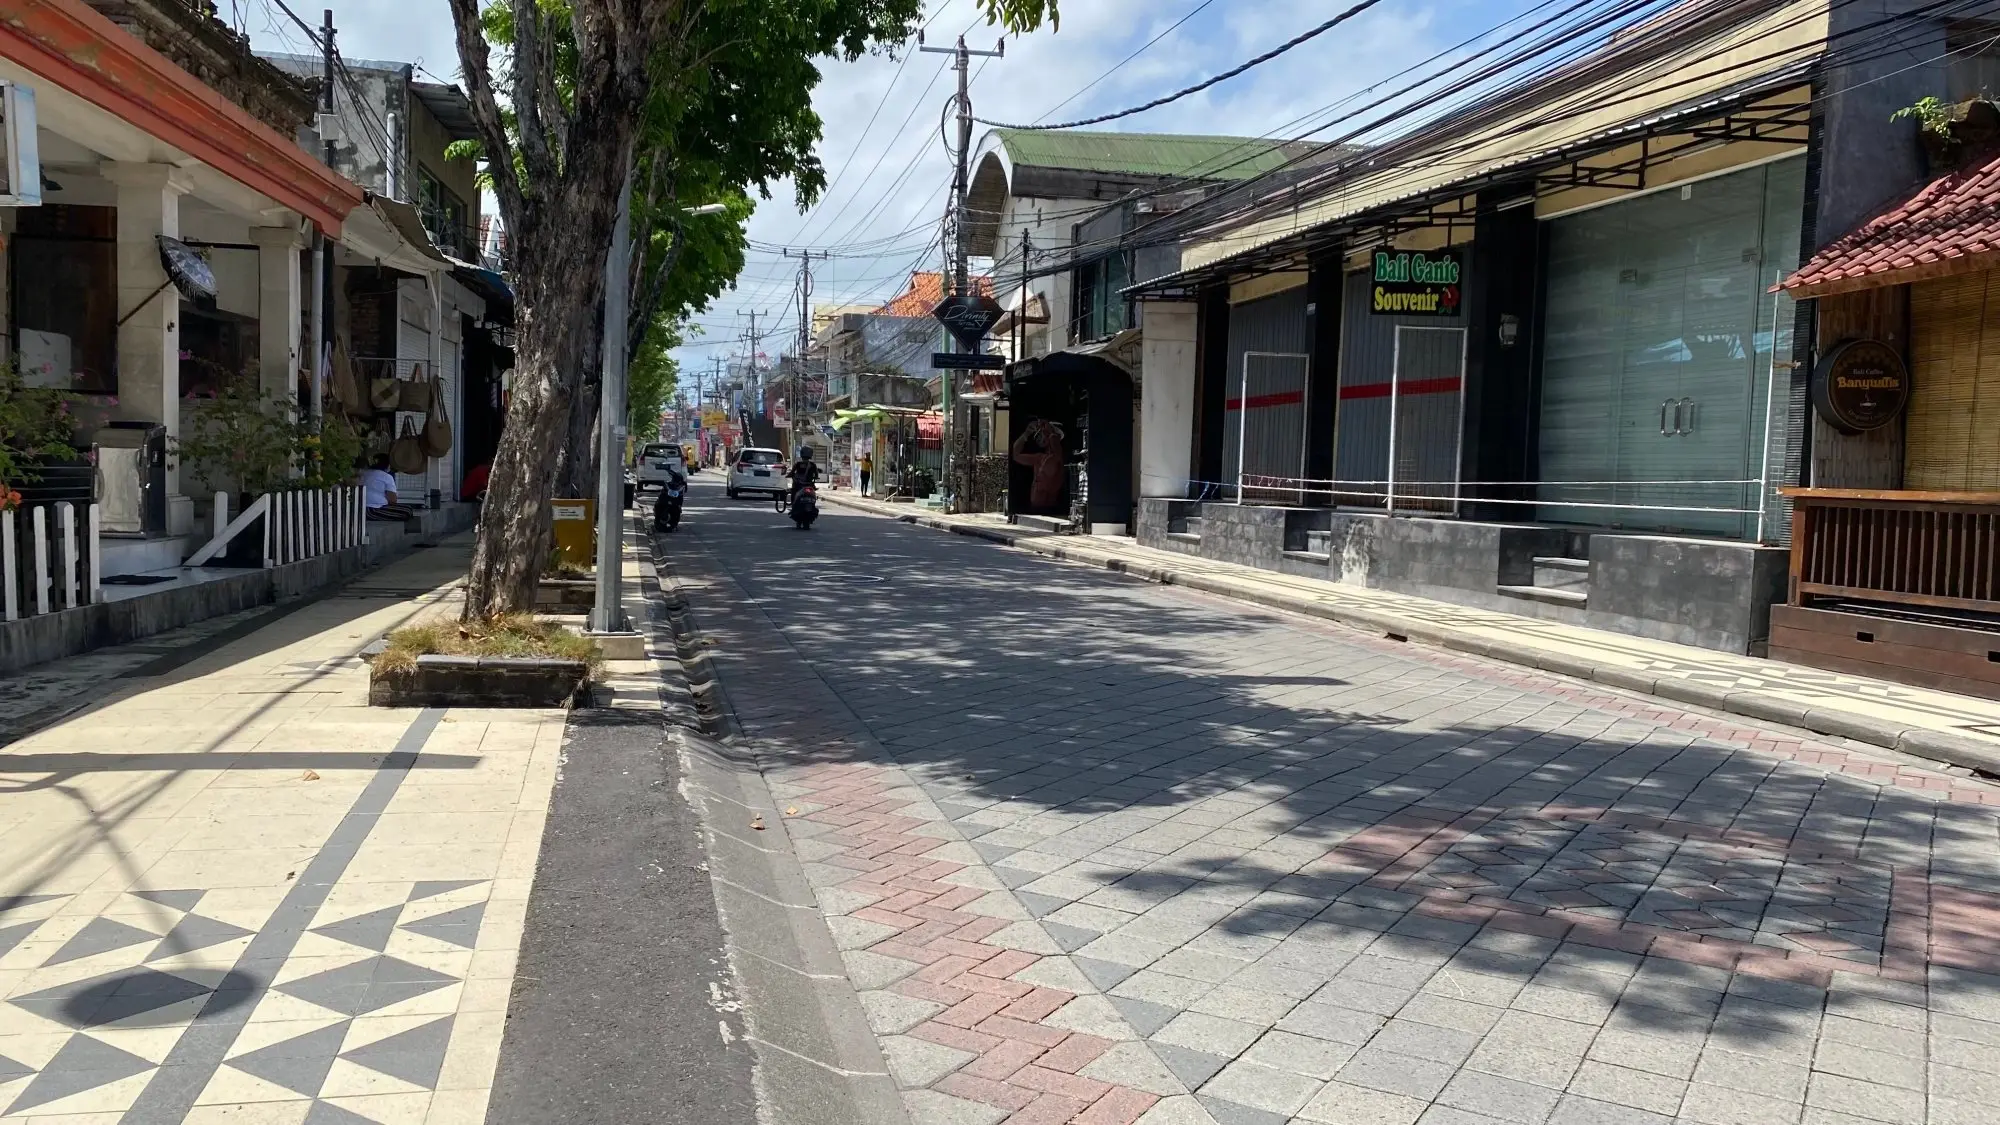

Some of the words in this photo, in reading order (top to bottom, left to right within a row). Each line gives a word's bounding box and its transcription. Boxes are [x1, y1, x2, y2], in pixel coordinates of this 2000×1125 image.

[1375, 252, 1409, 282] Bali
[1411, 253, 1459, 284] Ganic
[1374, 286, 1439, 311] Souvenir
